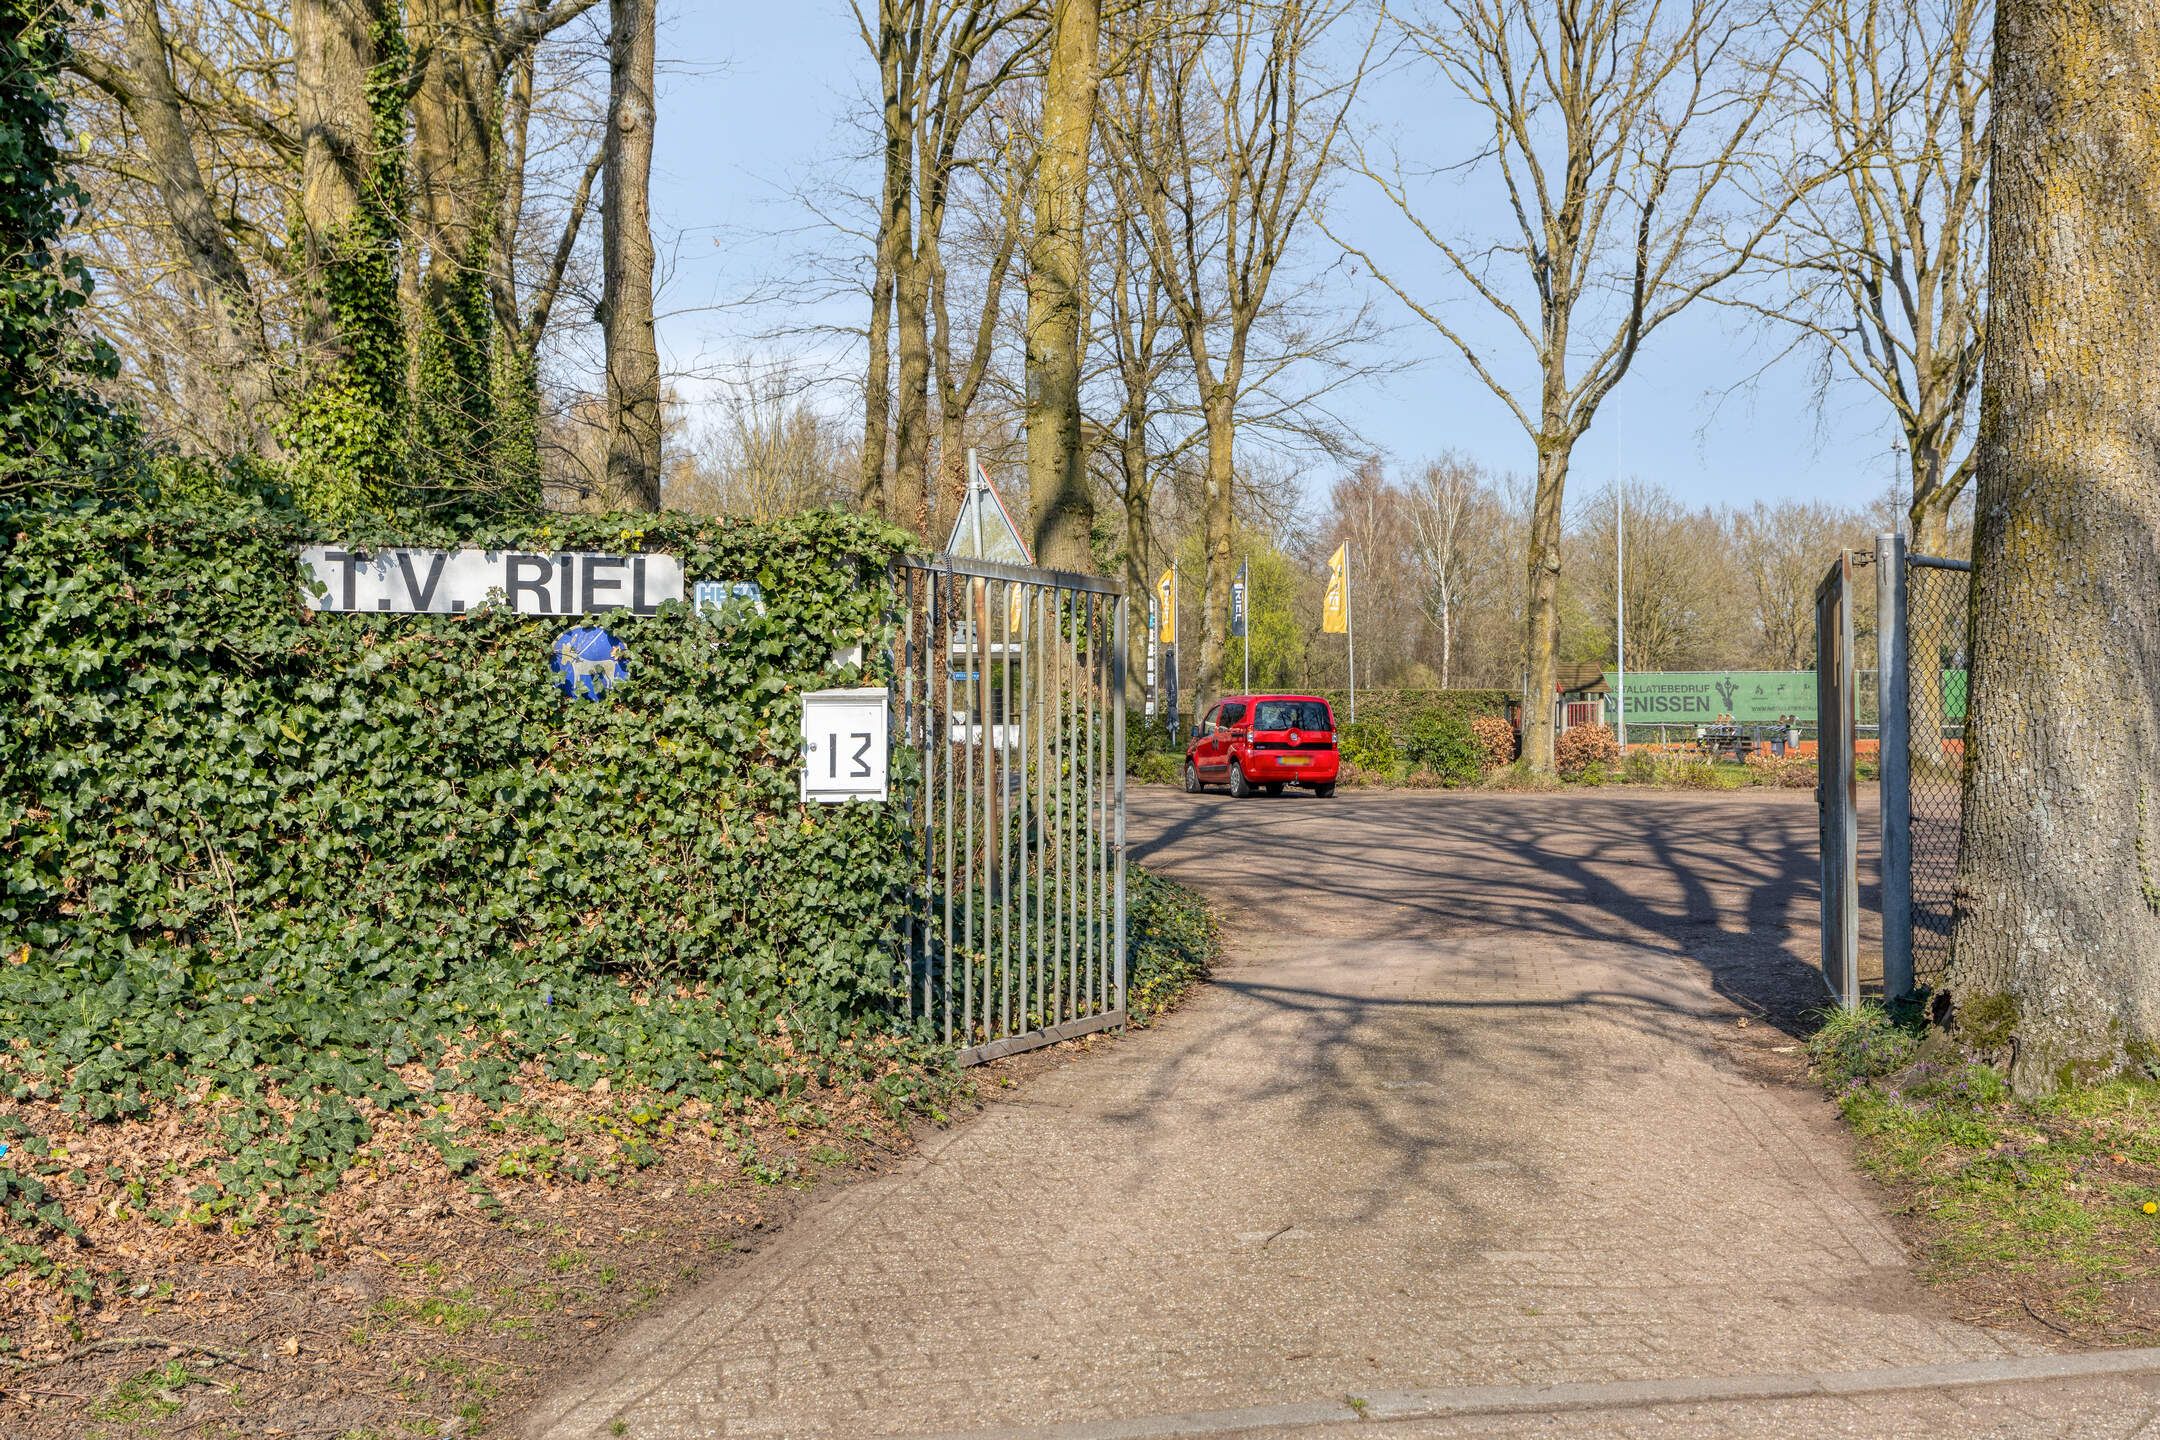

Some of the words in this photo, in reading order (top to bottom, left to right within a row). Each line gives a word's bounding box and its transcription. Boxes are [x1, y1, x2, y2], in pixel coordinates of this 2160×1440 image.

[324, 552, 465, 612] T.V.
[505, 554, 660, 615] RIEL
[830, 732, 872, 778] 13
